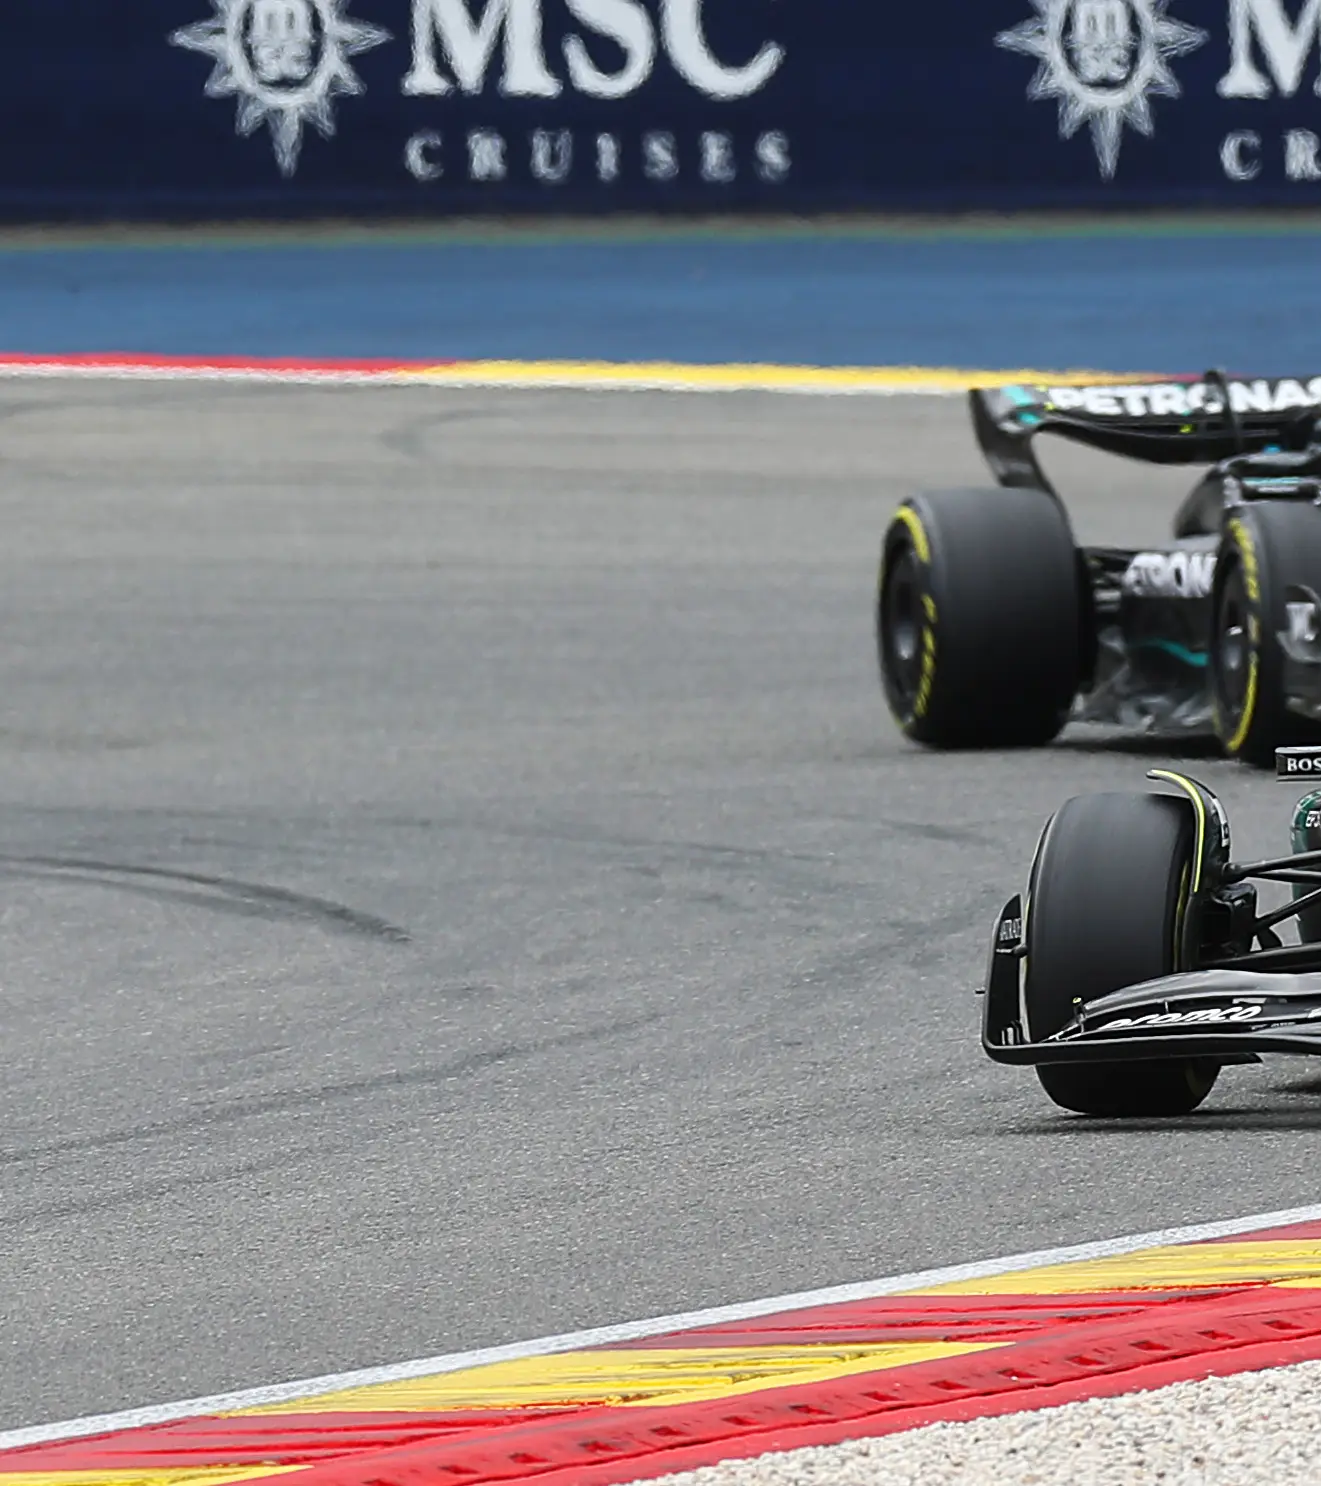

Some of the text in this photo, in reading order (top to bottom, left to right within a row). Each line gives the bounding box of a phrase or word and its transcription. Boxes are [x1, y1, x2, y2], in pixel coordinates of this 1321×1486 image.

[402, 0, 786, 98] MSC
[403, 128, 791, 182] CRUISES
[1101, 1005, 1263, 1030] aramco
